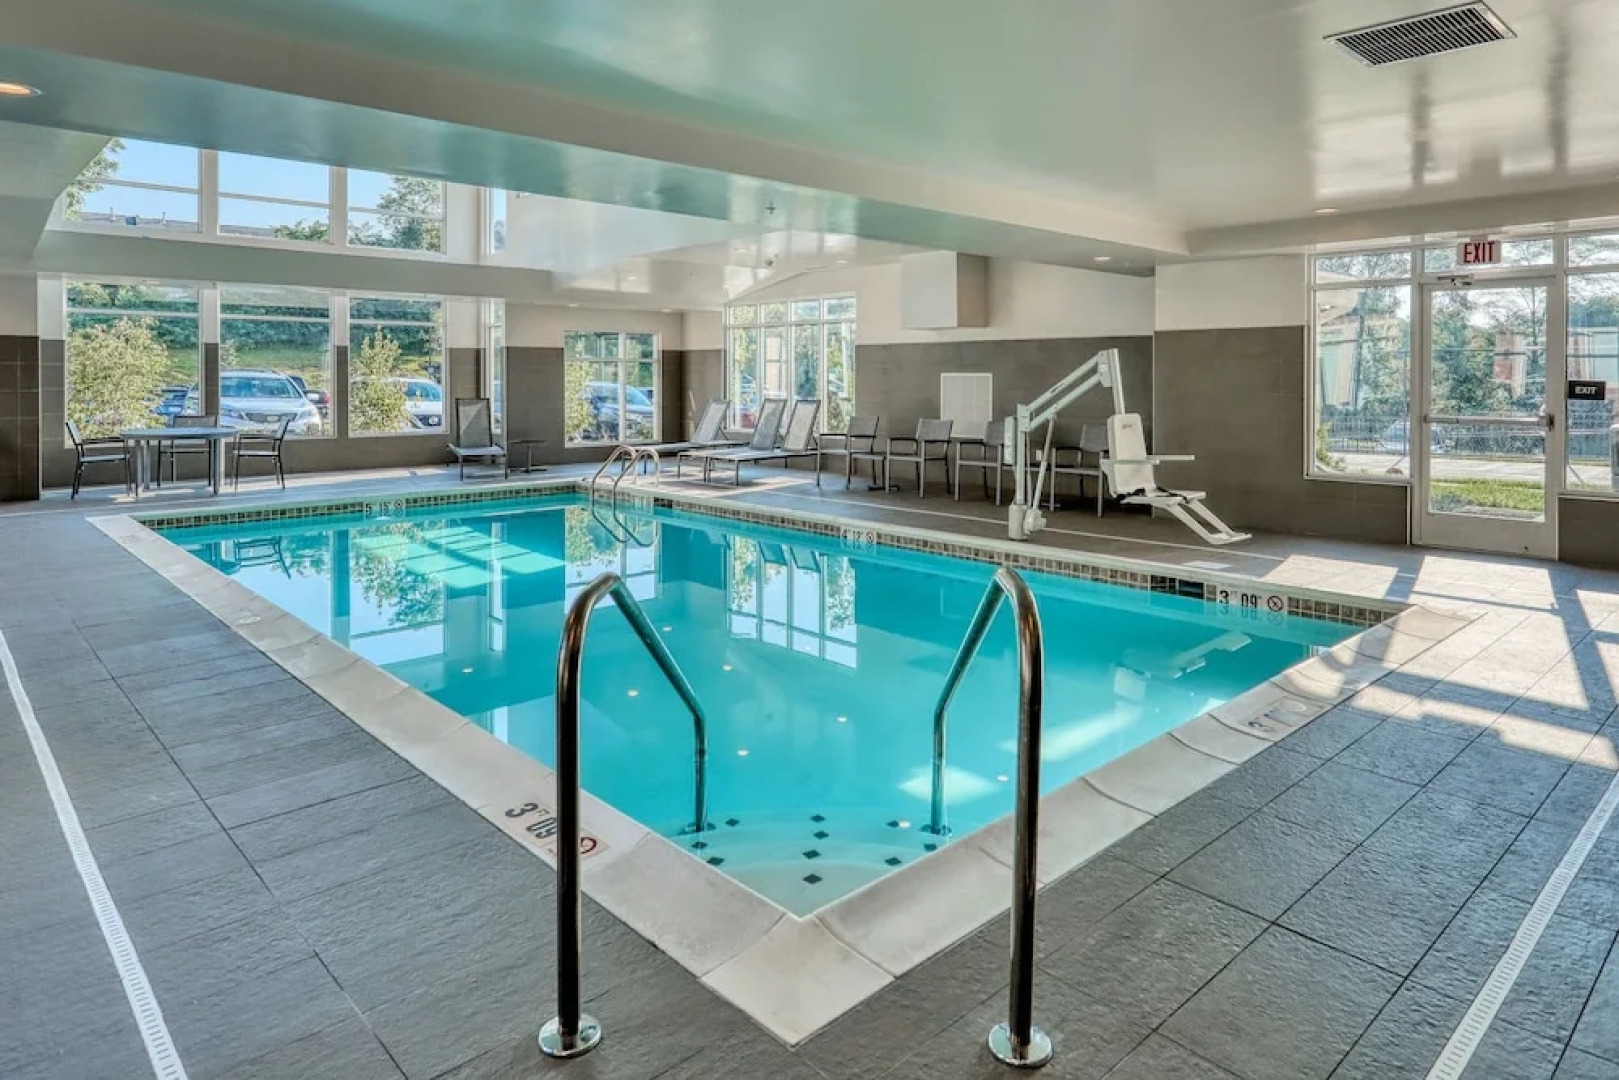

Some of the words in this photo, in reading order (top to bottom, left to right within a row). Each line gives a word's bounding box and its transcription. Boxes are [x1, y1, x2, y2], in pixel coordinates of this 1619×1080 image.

[1463, 240, 1495, 264] EXIT
[1574, 386, 1597, 395] EXIT
[1219, 589, 1230, 604] 3
[504, 802, 539, 818] 3
